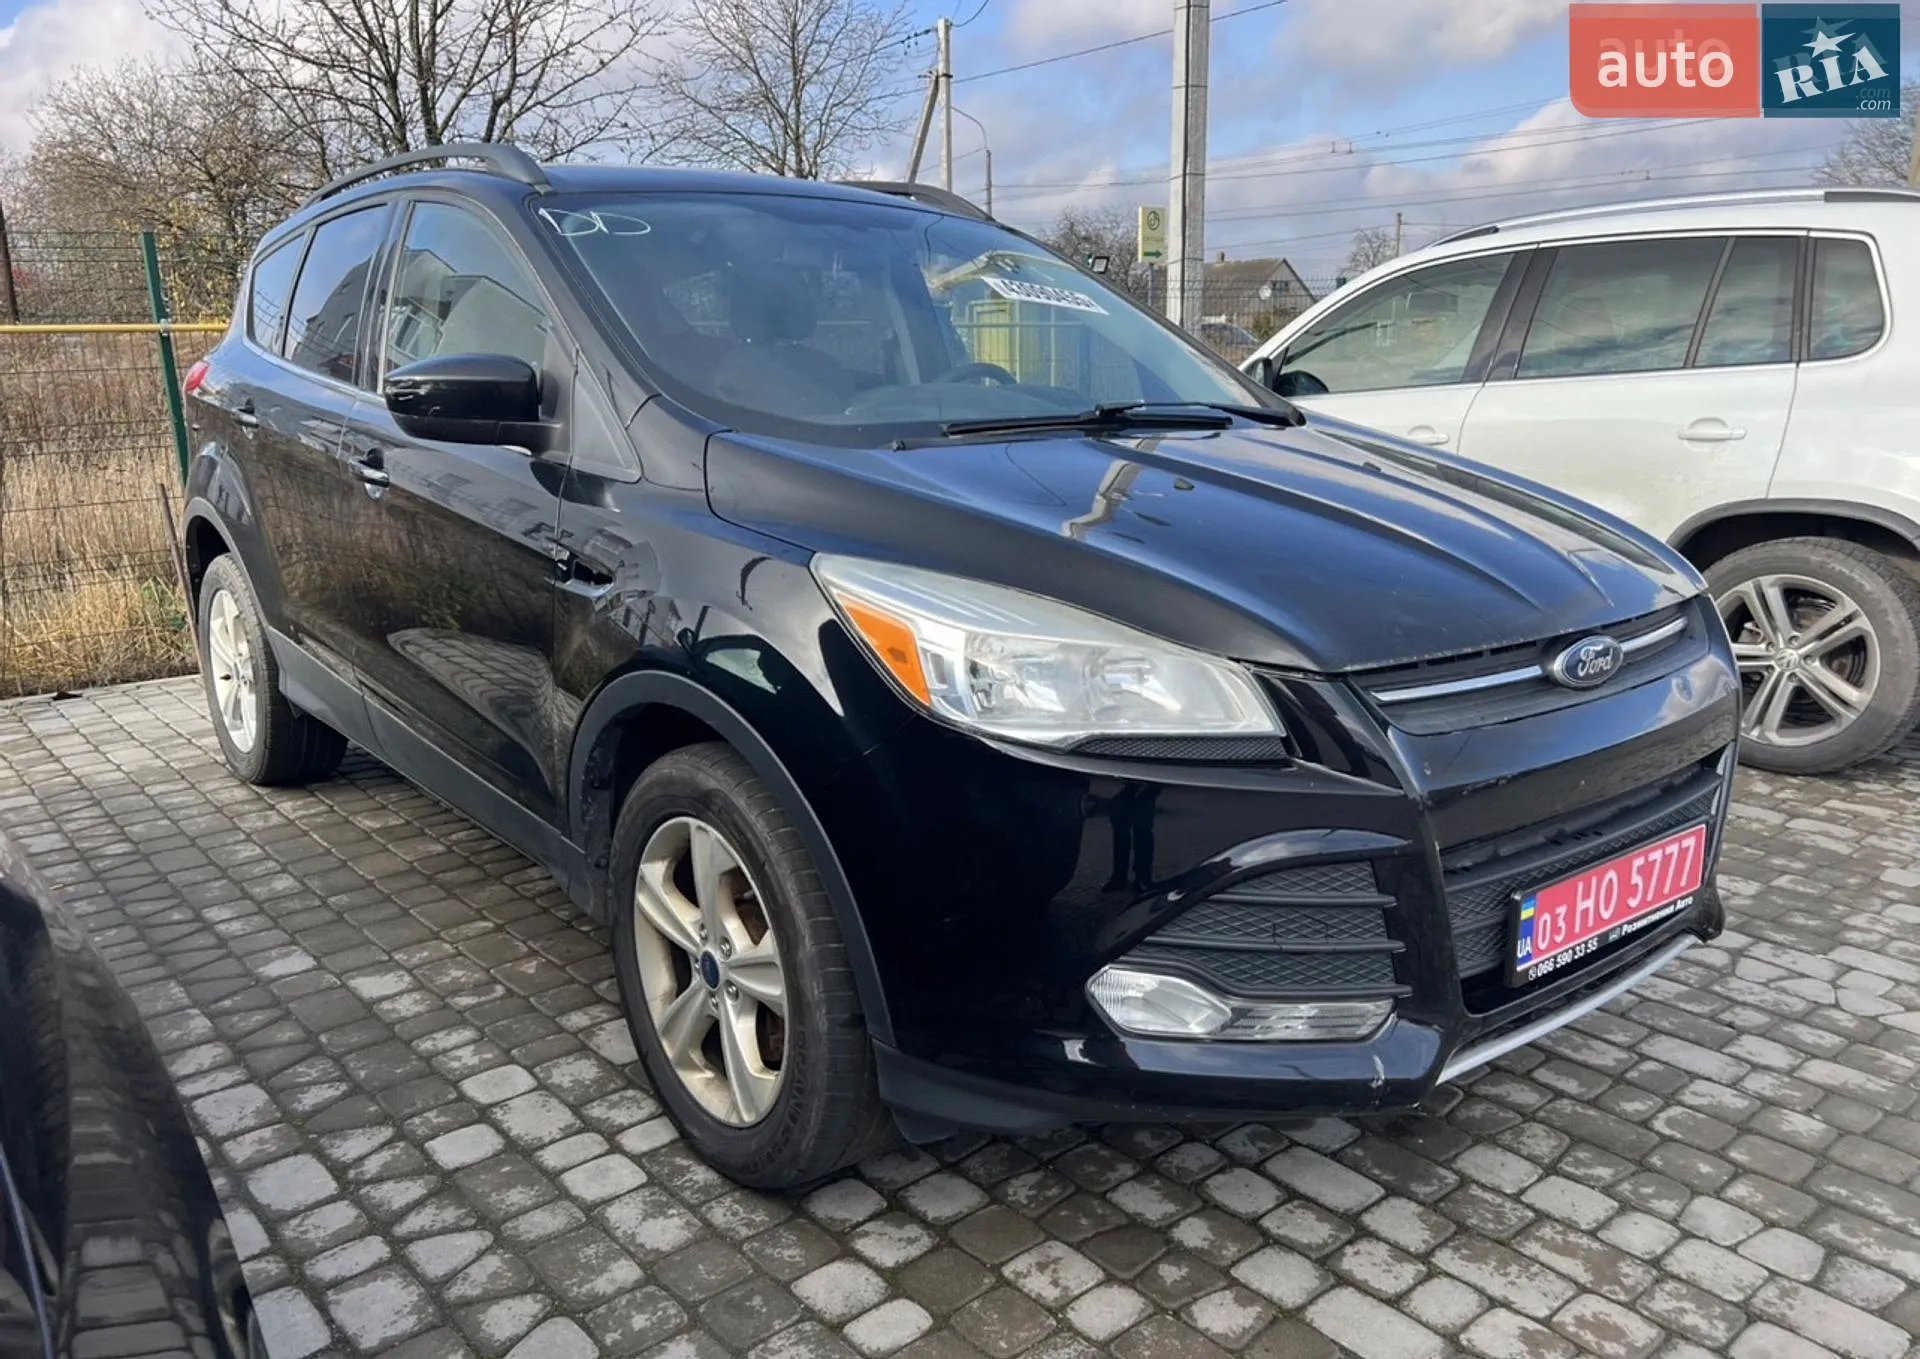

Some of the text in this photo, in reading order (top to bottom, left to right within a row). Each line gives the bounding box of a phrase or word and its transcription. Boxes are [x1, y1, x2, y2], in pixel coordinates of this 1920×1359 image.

[1577, 643, 1613, 677] Ford
[1537, 904, 1568, 950] 03
[1627, 836, 1697, 909] 5777
[1517, 936, 1533, 959] UA
